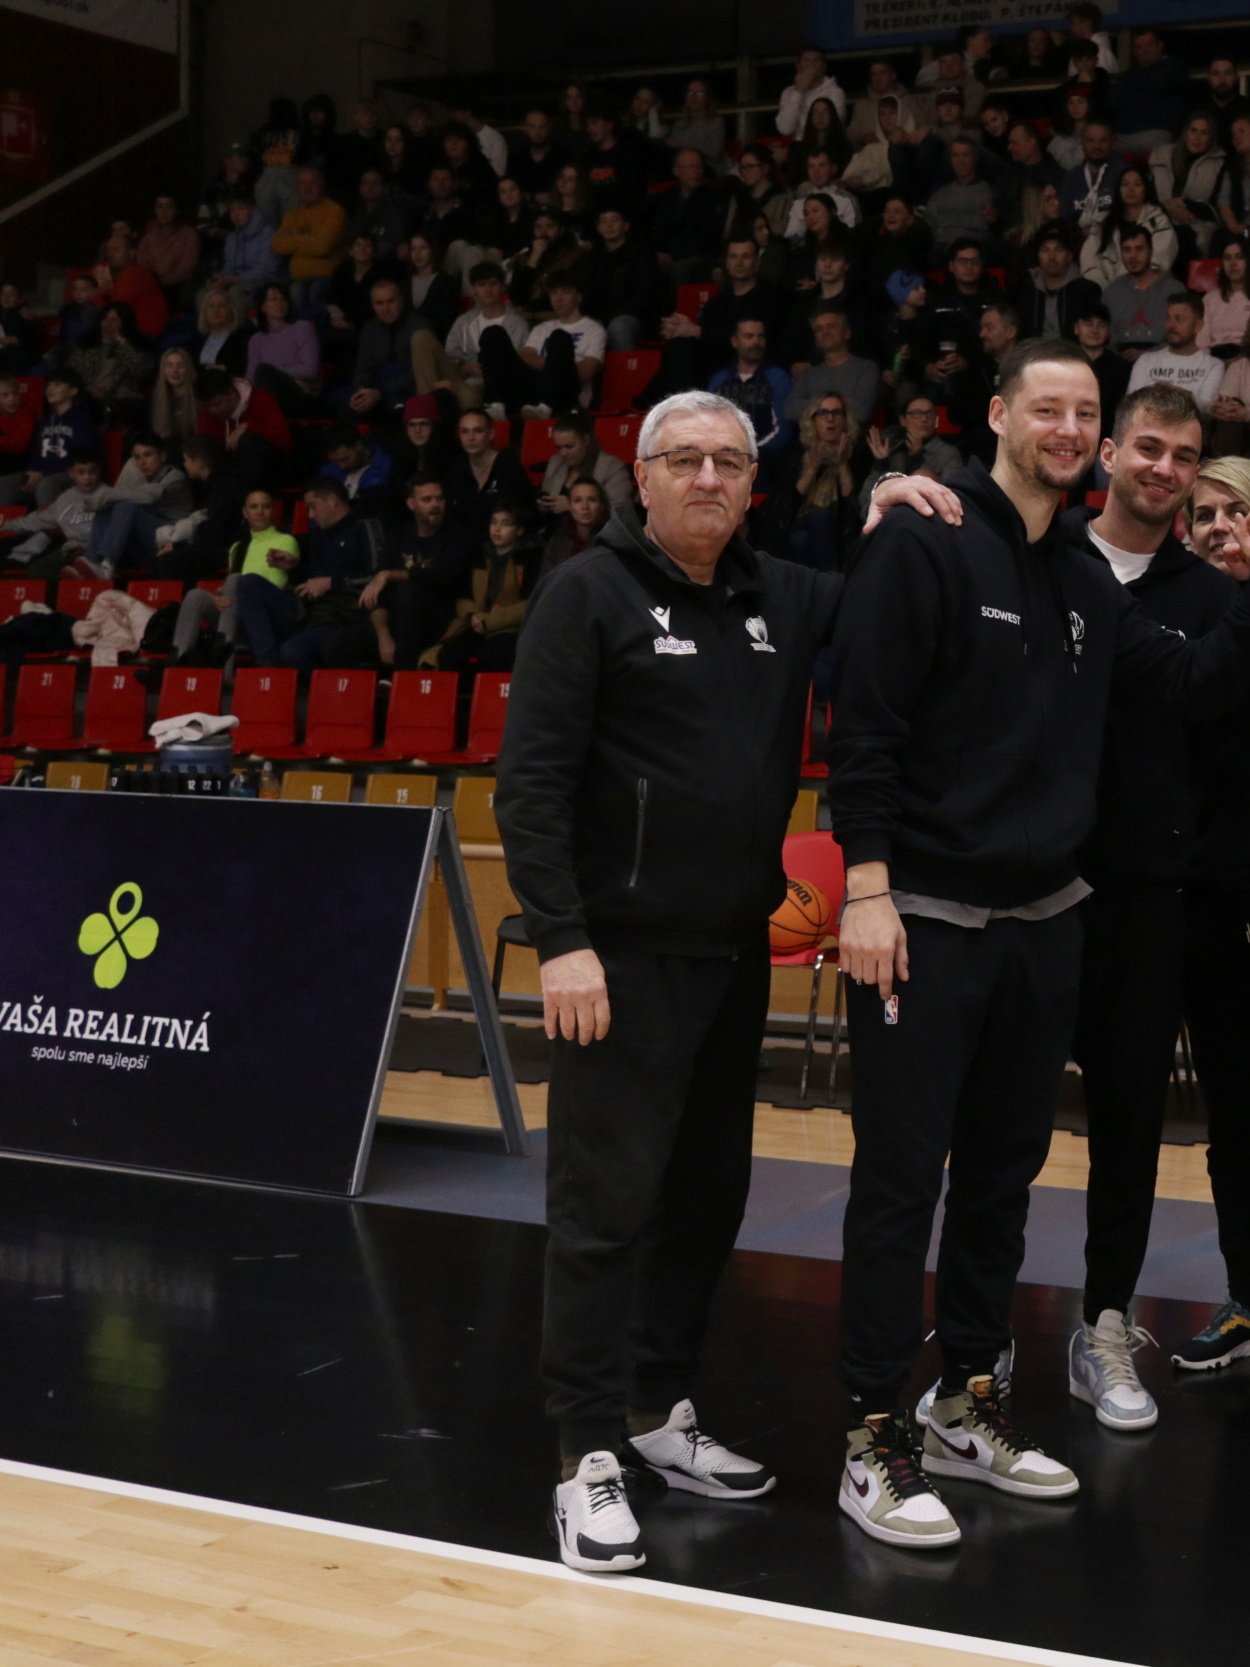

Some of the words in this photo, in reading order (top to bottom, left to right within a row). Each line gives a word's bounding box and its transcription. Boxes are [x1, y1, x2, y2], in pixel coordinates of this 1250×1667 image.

[864, 13, 938, 31] PREZIDENT
[981, 606, 1021, 626] SÜDWEST
[338, 678, 349, 692] 17
[421, 679, 432, 694] 16
[312, 785, 324, 800] 16
[396, 788, 409, 804] 15
[0, 994, 58, 1036] VAŠA
[63, 1008, 212, 1053] REALITNÁ
[31, 1045, 66, 1062] spolu
[68, 1049, 95, 1065] sme
[97, 1052, 151, 1072] najlepší
